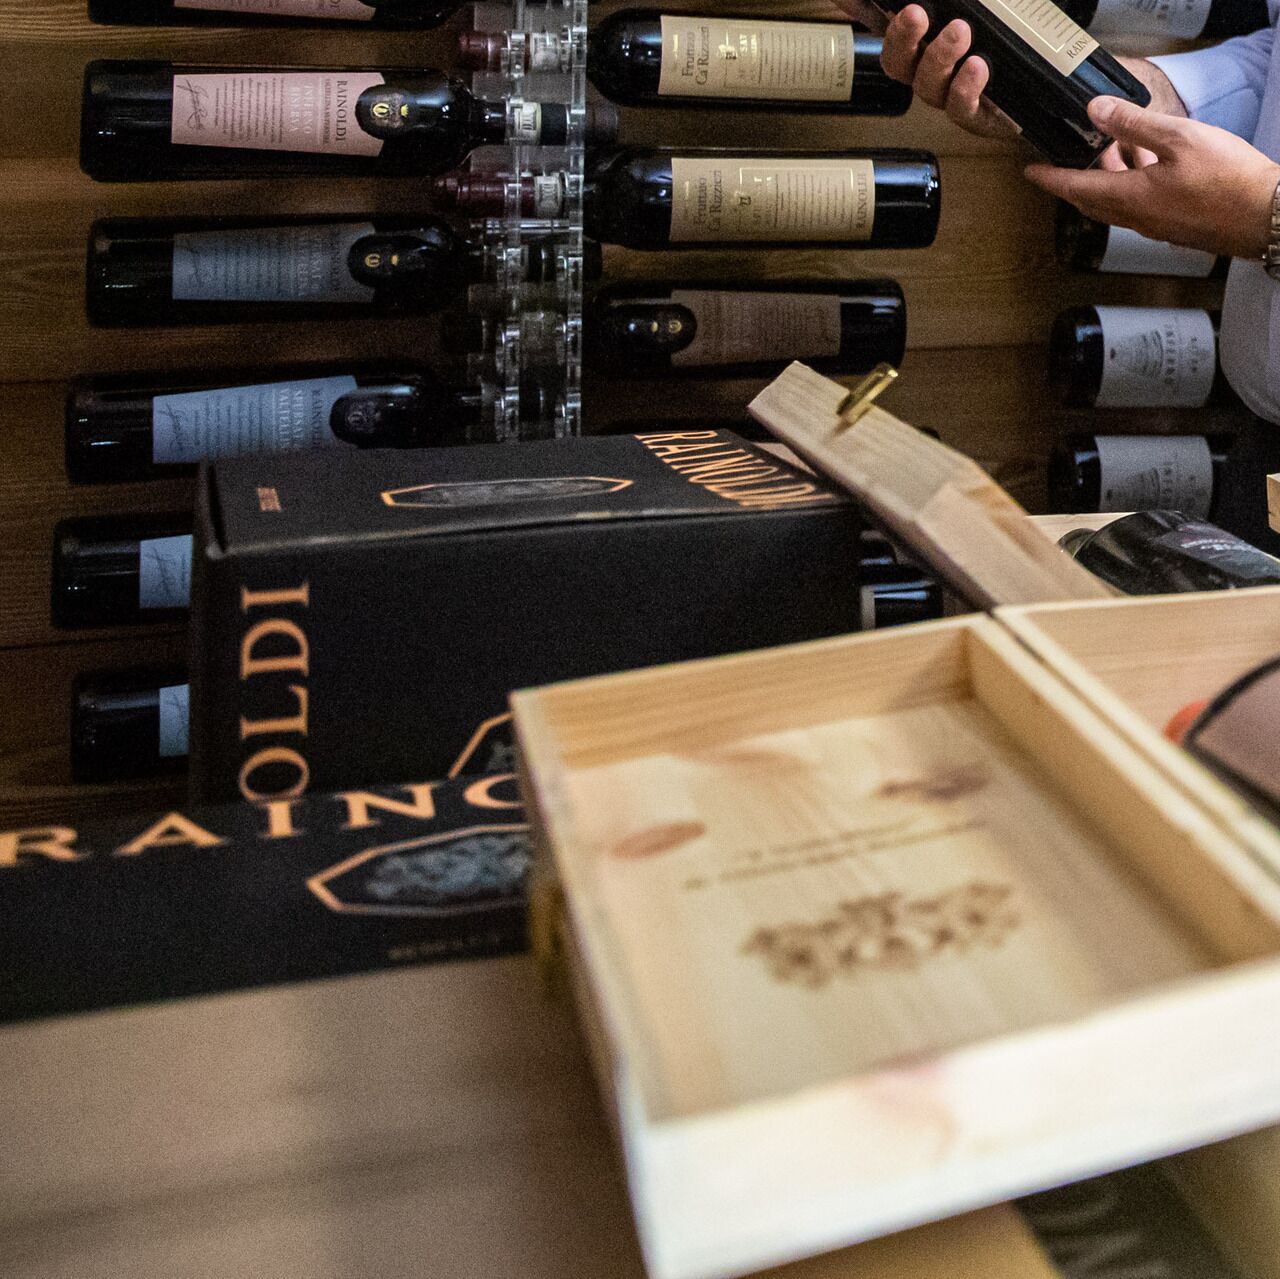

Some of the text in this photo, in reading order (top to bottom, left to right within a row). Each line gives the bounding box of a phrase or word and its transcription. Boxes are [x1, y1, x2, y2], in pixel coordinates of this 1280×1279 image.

[335, 80, 348, 142] RAINOLDI
[633, 429, 835, 507] RAINOLDI
[239, 581, 310, 802] OLDI
